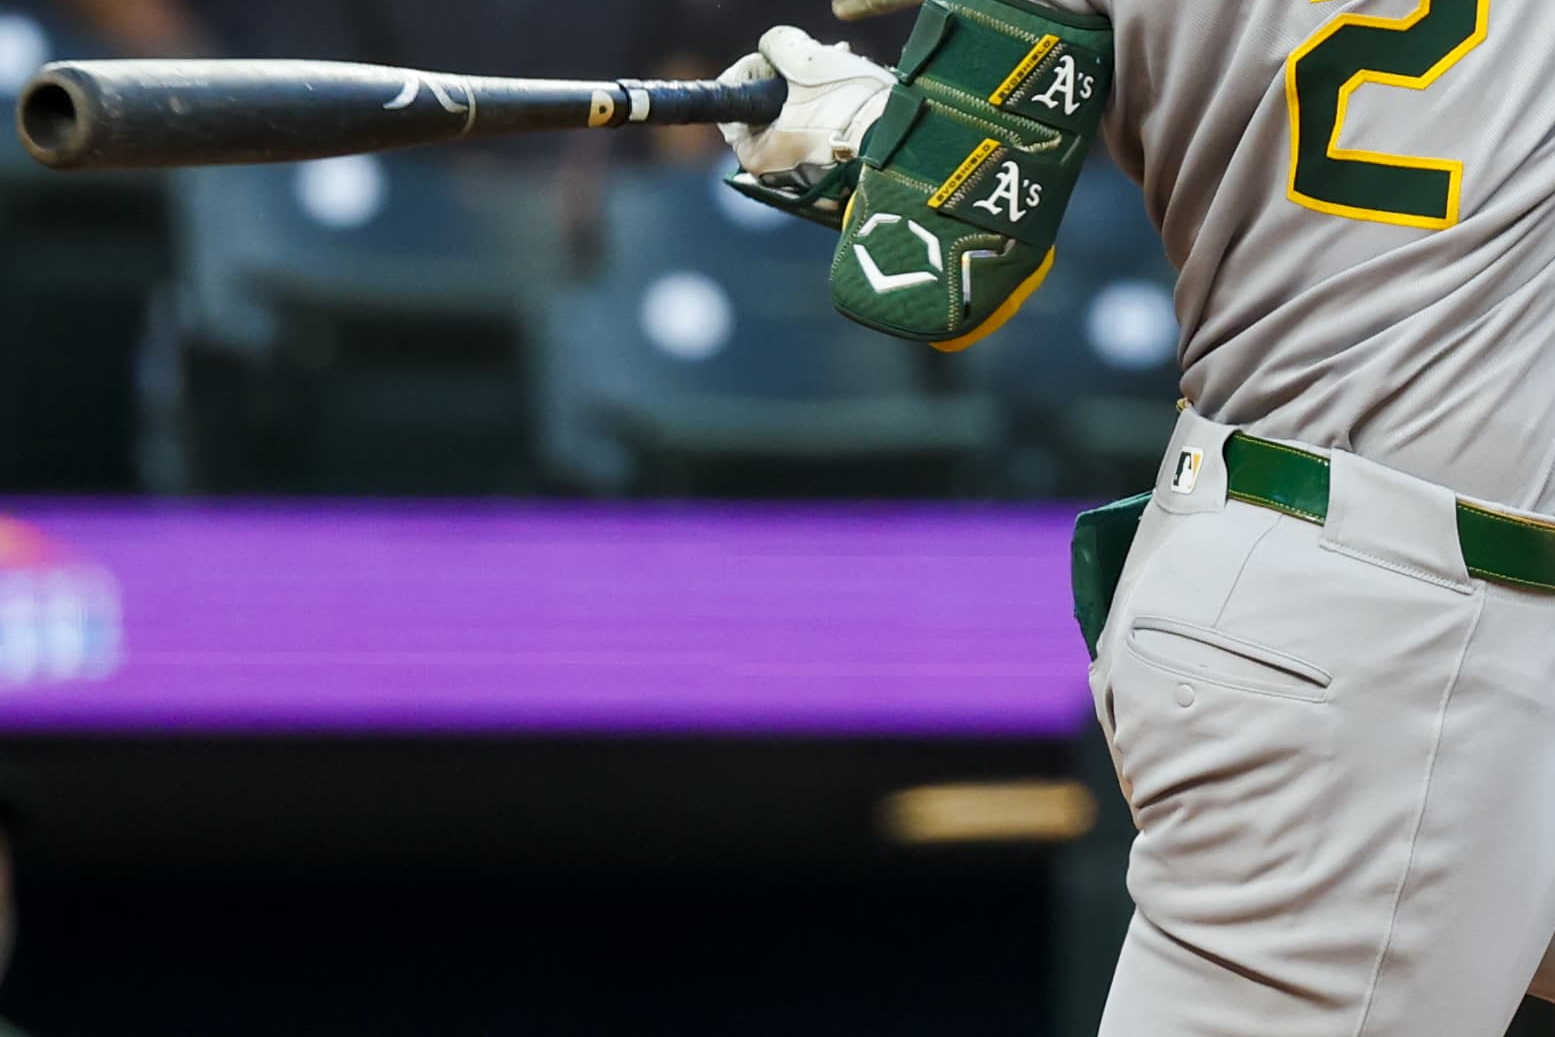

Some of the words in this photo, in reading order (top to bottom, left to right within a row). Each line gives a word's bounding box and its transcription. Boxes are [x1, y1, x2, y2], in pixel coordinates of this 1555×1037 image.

[1031, 55, 1094, 115] A's
[935, 144, 991, 202] EVOSHIELD
[972, 161, 1042, 222] A's
